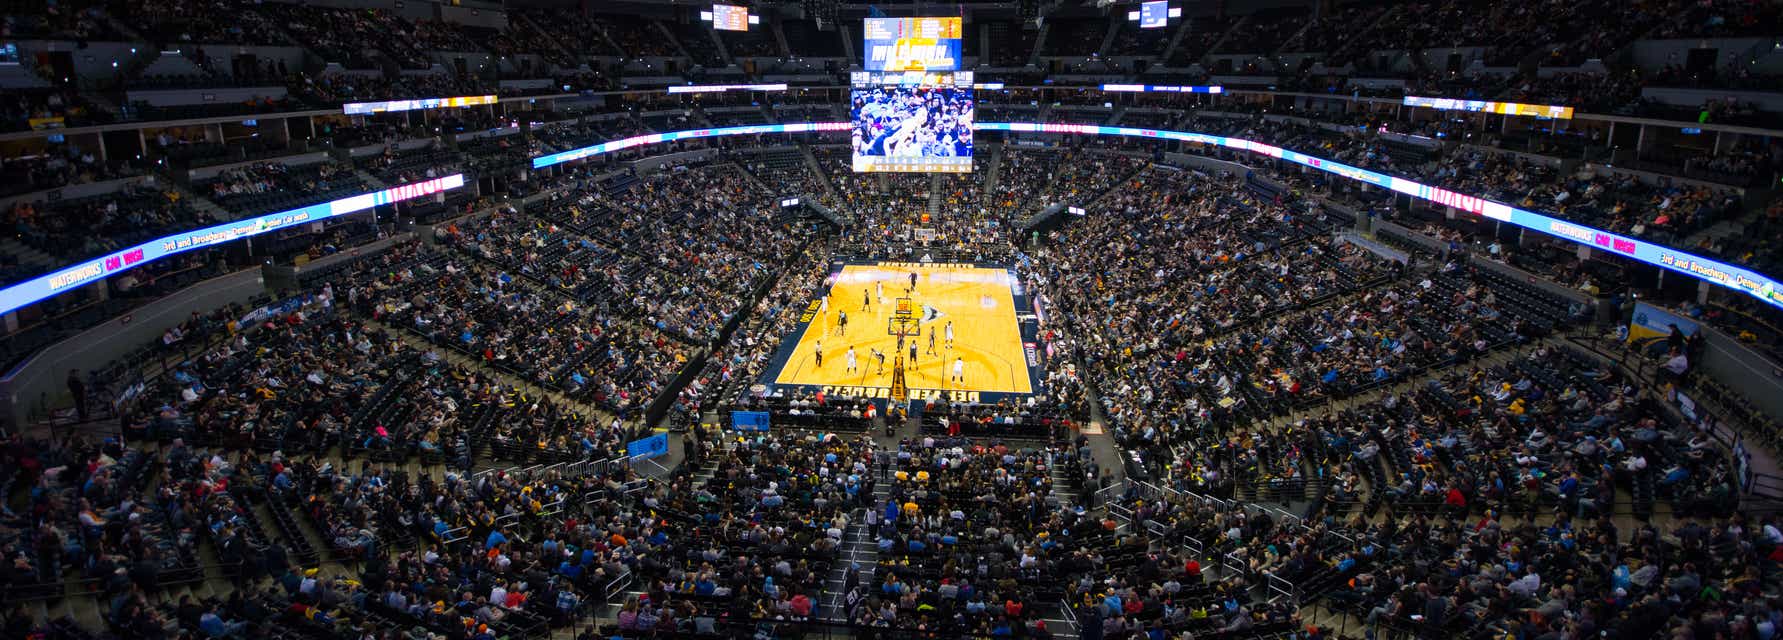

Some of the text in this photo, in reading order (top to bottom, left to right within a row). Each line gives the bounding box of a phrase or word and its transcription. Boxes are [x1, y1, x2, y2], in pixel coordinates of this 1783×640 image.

[163, 238, 176, 252] 3rd
[177, 236, 192, 249] and
[1595, 232, 1611, 248] CAR
[1613, 237, 1636, 255] WASH
[105, 255, 121, 271] CAR
[123, 248, 144, 265] WASH
[1661, 253, 1675, 265] 3rd
[1675, 258, 1691, 270] and
